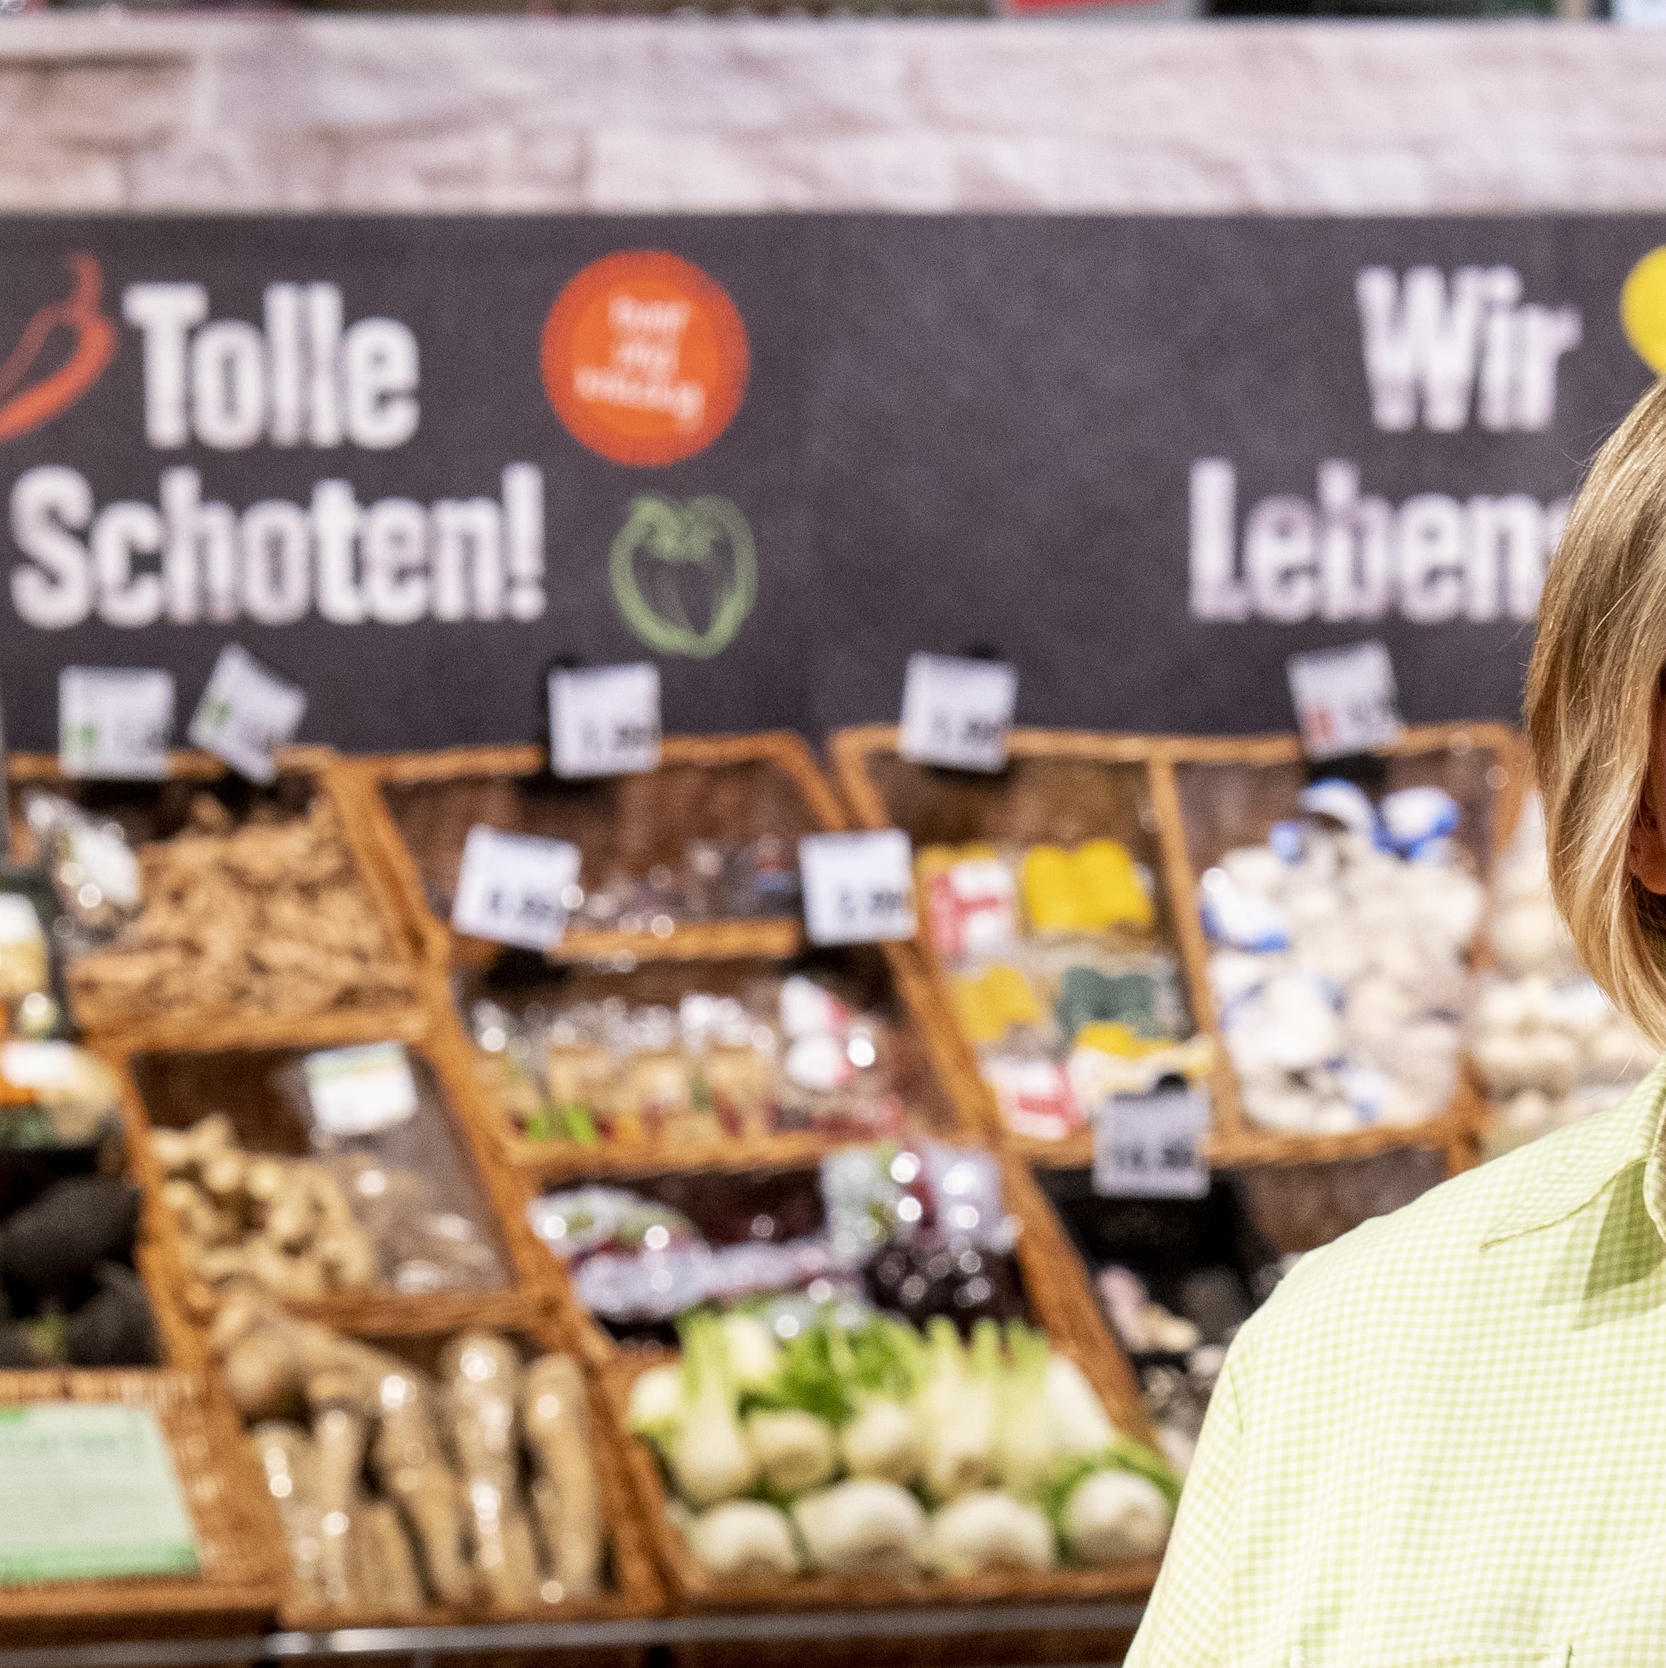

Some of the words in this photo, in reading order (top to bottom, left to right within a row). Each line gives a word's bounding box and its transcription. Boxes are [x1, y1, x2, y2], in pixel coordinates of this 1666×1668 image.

[124, 281, 421, 451] Tolle
[1354, 264, 1583, 432] Wir
[9, 462, 546, 629] Schoten!
